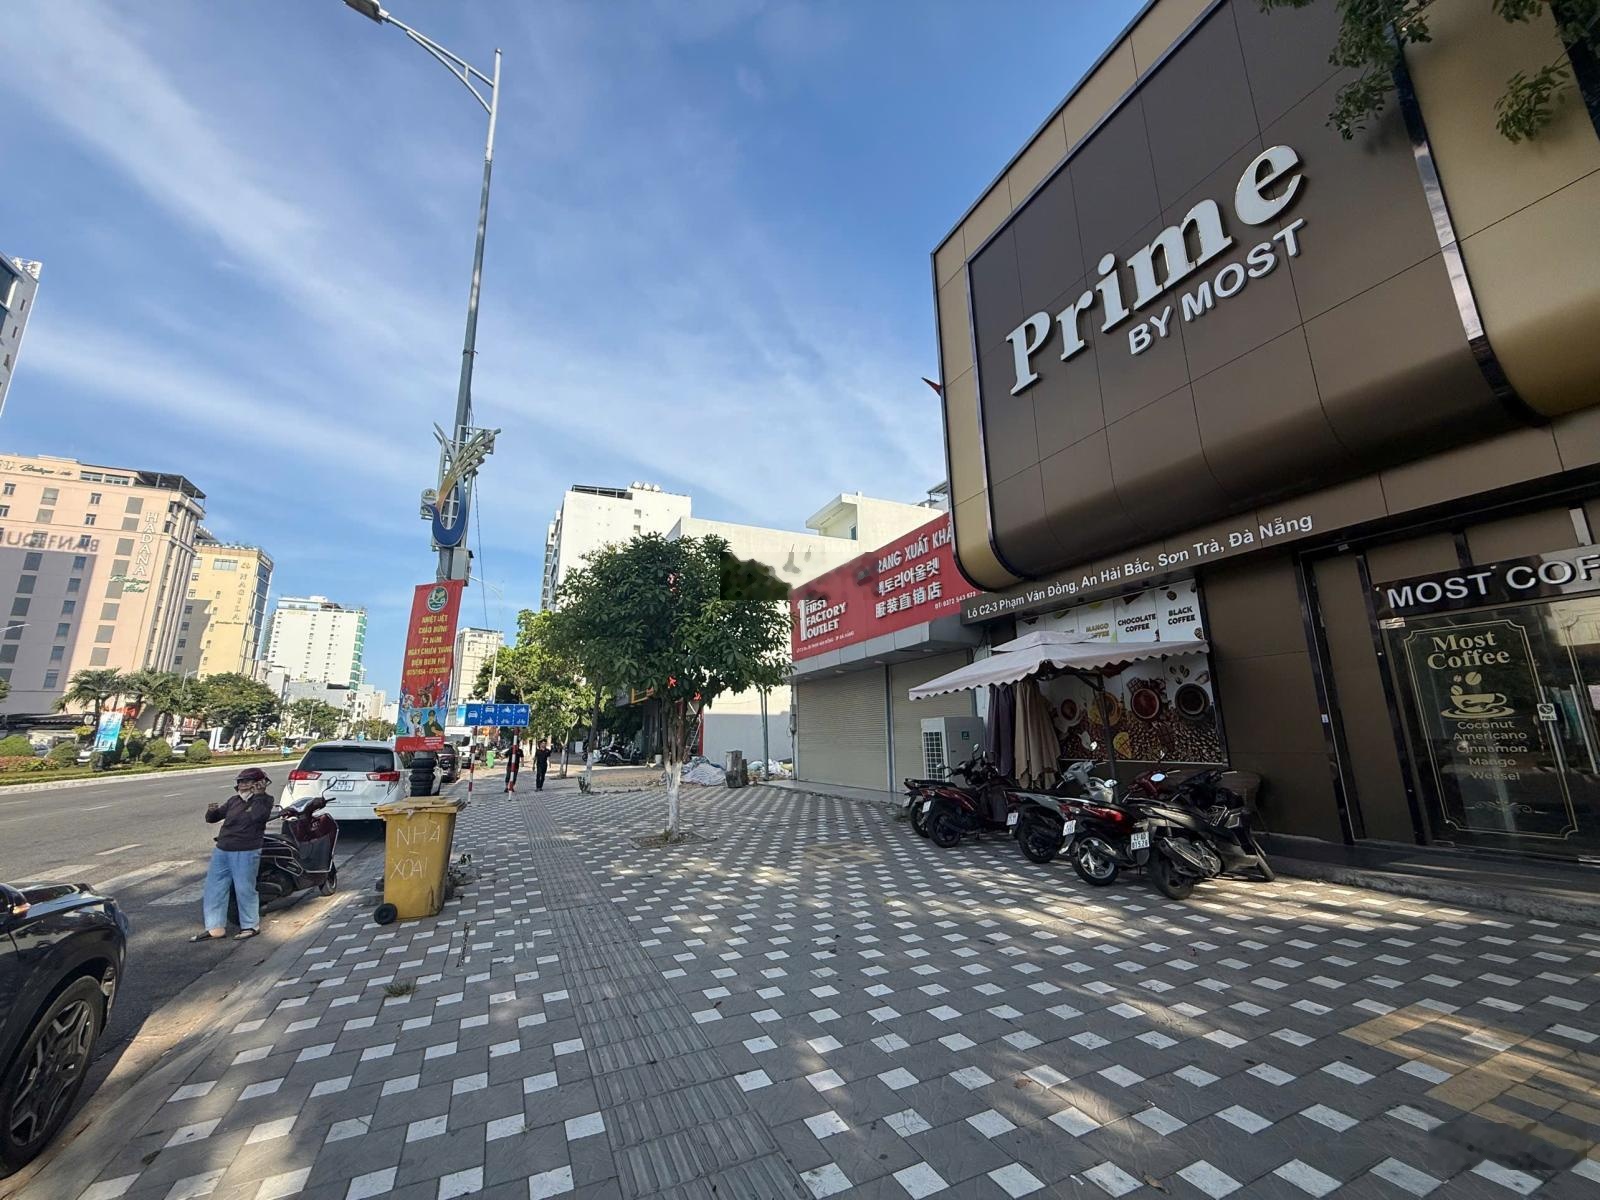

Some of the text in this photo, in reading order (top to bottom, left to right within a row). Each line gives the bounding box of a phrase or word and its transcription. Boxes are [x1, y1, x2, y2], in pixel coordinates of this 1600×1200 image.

[1005, 145, 1304, 395] Prime
[1128, 218, 1306, 355] BY MOST
[133, 512, 159, 576] HADANA
[904, 533, 929, 562] XUẤT
[979, 602, 998, 615] C2-3
[999, 595, 1025, 611] Phạm
[1027, 588, 1046, 602] Văn
[1047, 580, 1080, 600] Đồng,
[1081, 573, 1098, 587] An
[1124, 557, 1155, 577] Bắc,
[1158, 548, 1189, 567] Sơn
[1193, 538, 1225, 557] Trà,
[1229, 527, 1254, 547] Đà
[1259, 514, 1314, 541] Nẵng
[1386, 571, 1493, 609] MOST
[806, 600, 827, 614] FIRST
[806, 602, 846, 626] FACTORY
[1168, 606, 1193, 617] BLACK
[807, 618, 839, 638] OUTLET
[1085, 622, 1109, 632] MANGO
[1117, 613, 1156, 626] CHOCOLATE
[1125, 623, 1150, 633] COFFEE
[1167, 614, 1196, 625] COFFEE
[1432, 631, 1497, 651] Most
[1427, 649, 1511, 670] Coffee
[1457, 720, 1516, 730] Coconut
[1453, 732, 1528, 741] Americano
[1456, 743, 1528, 753] Cinnamon
[1468, 757, 1517, 768] Mango
[396, 819, 440, 848] NHÀ
